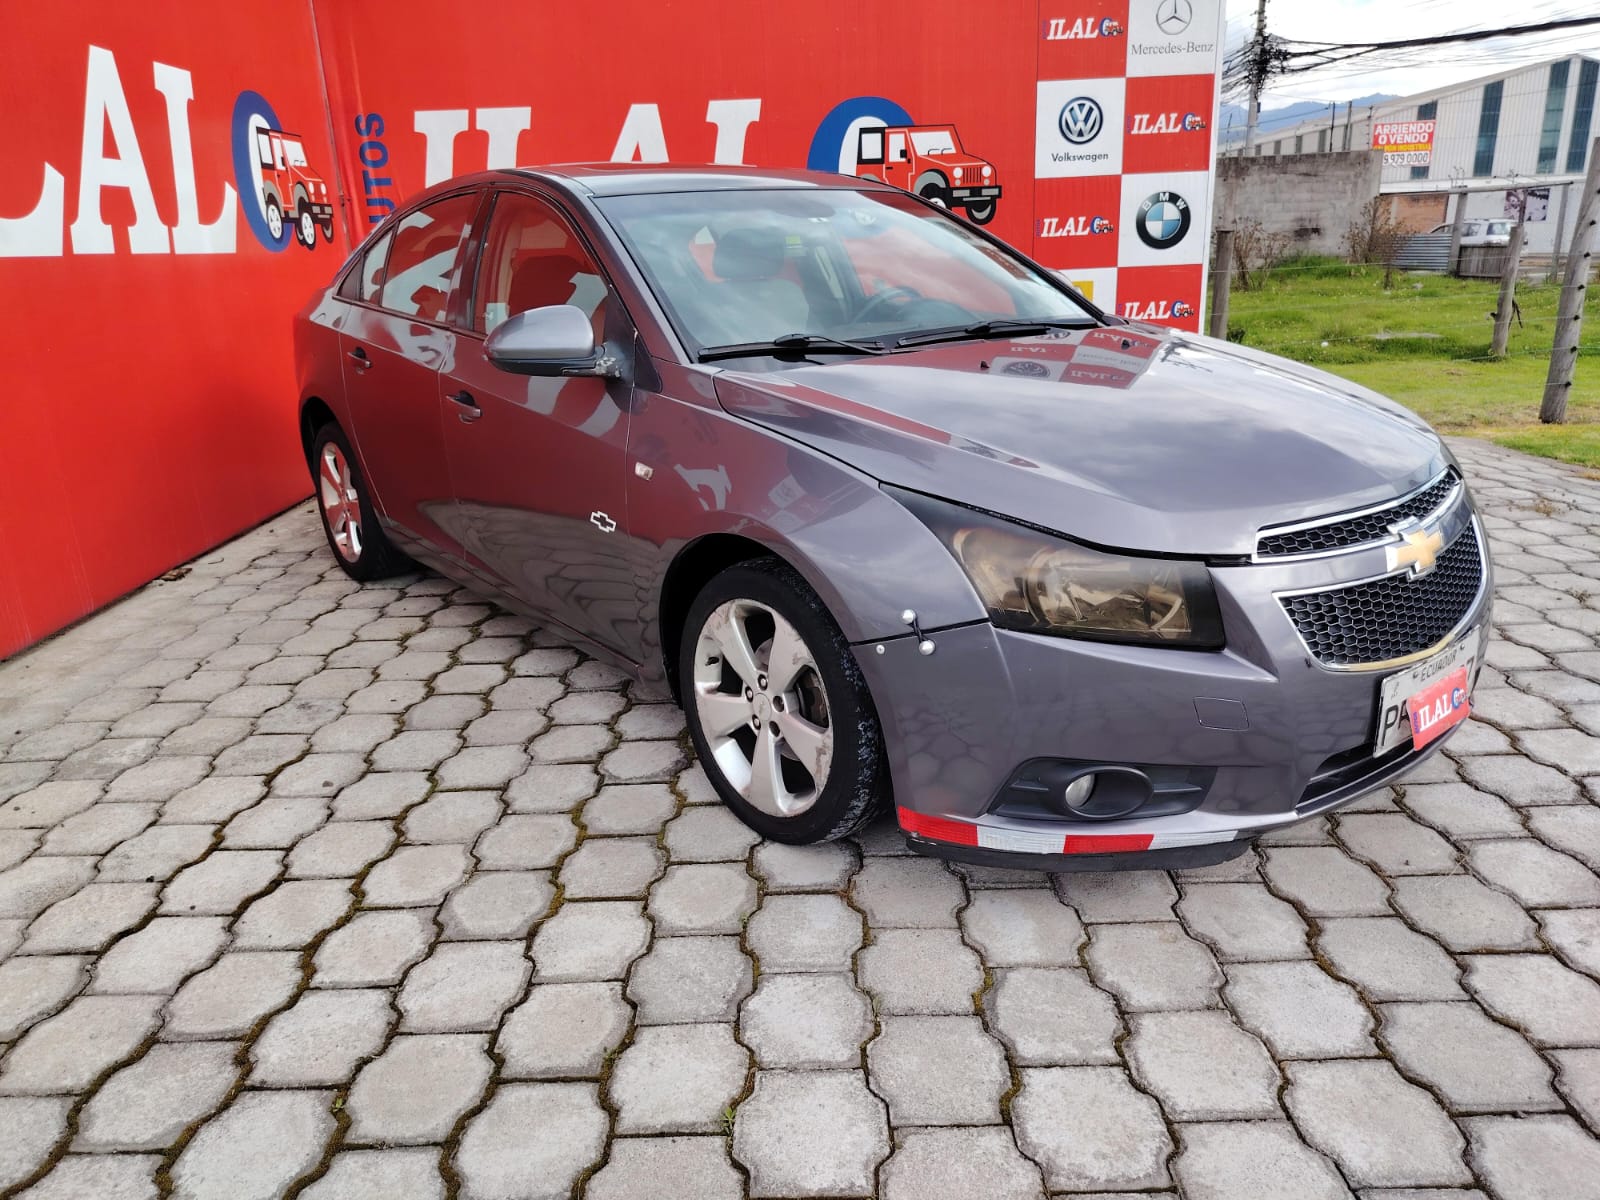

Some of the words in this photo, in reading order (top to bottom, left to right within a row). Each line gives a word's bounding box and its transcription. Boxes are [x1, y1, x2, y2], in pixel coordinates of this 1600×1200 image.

[1131, 41, 1214, 56] Mercedes-Benz
[1375, 123, 1434, 135] ARRIENDO
[1378, 134, 1387, 145] O
[1389, 133, 1429, 144] VENDO
[1051, 152, 1109, 163] Volkswagen
